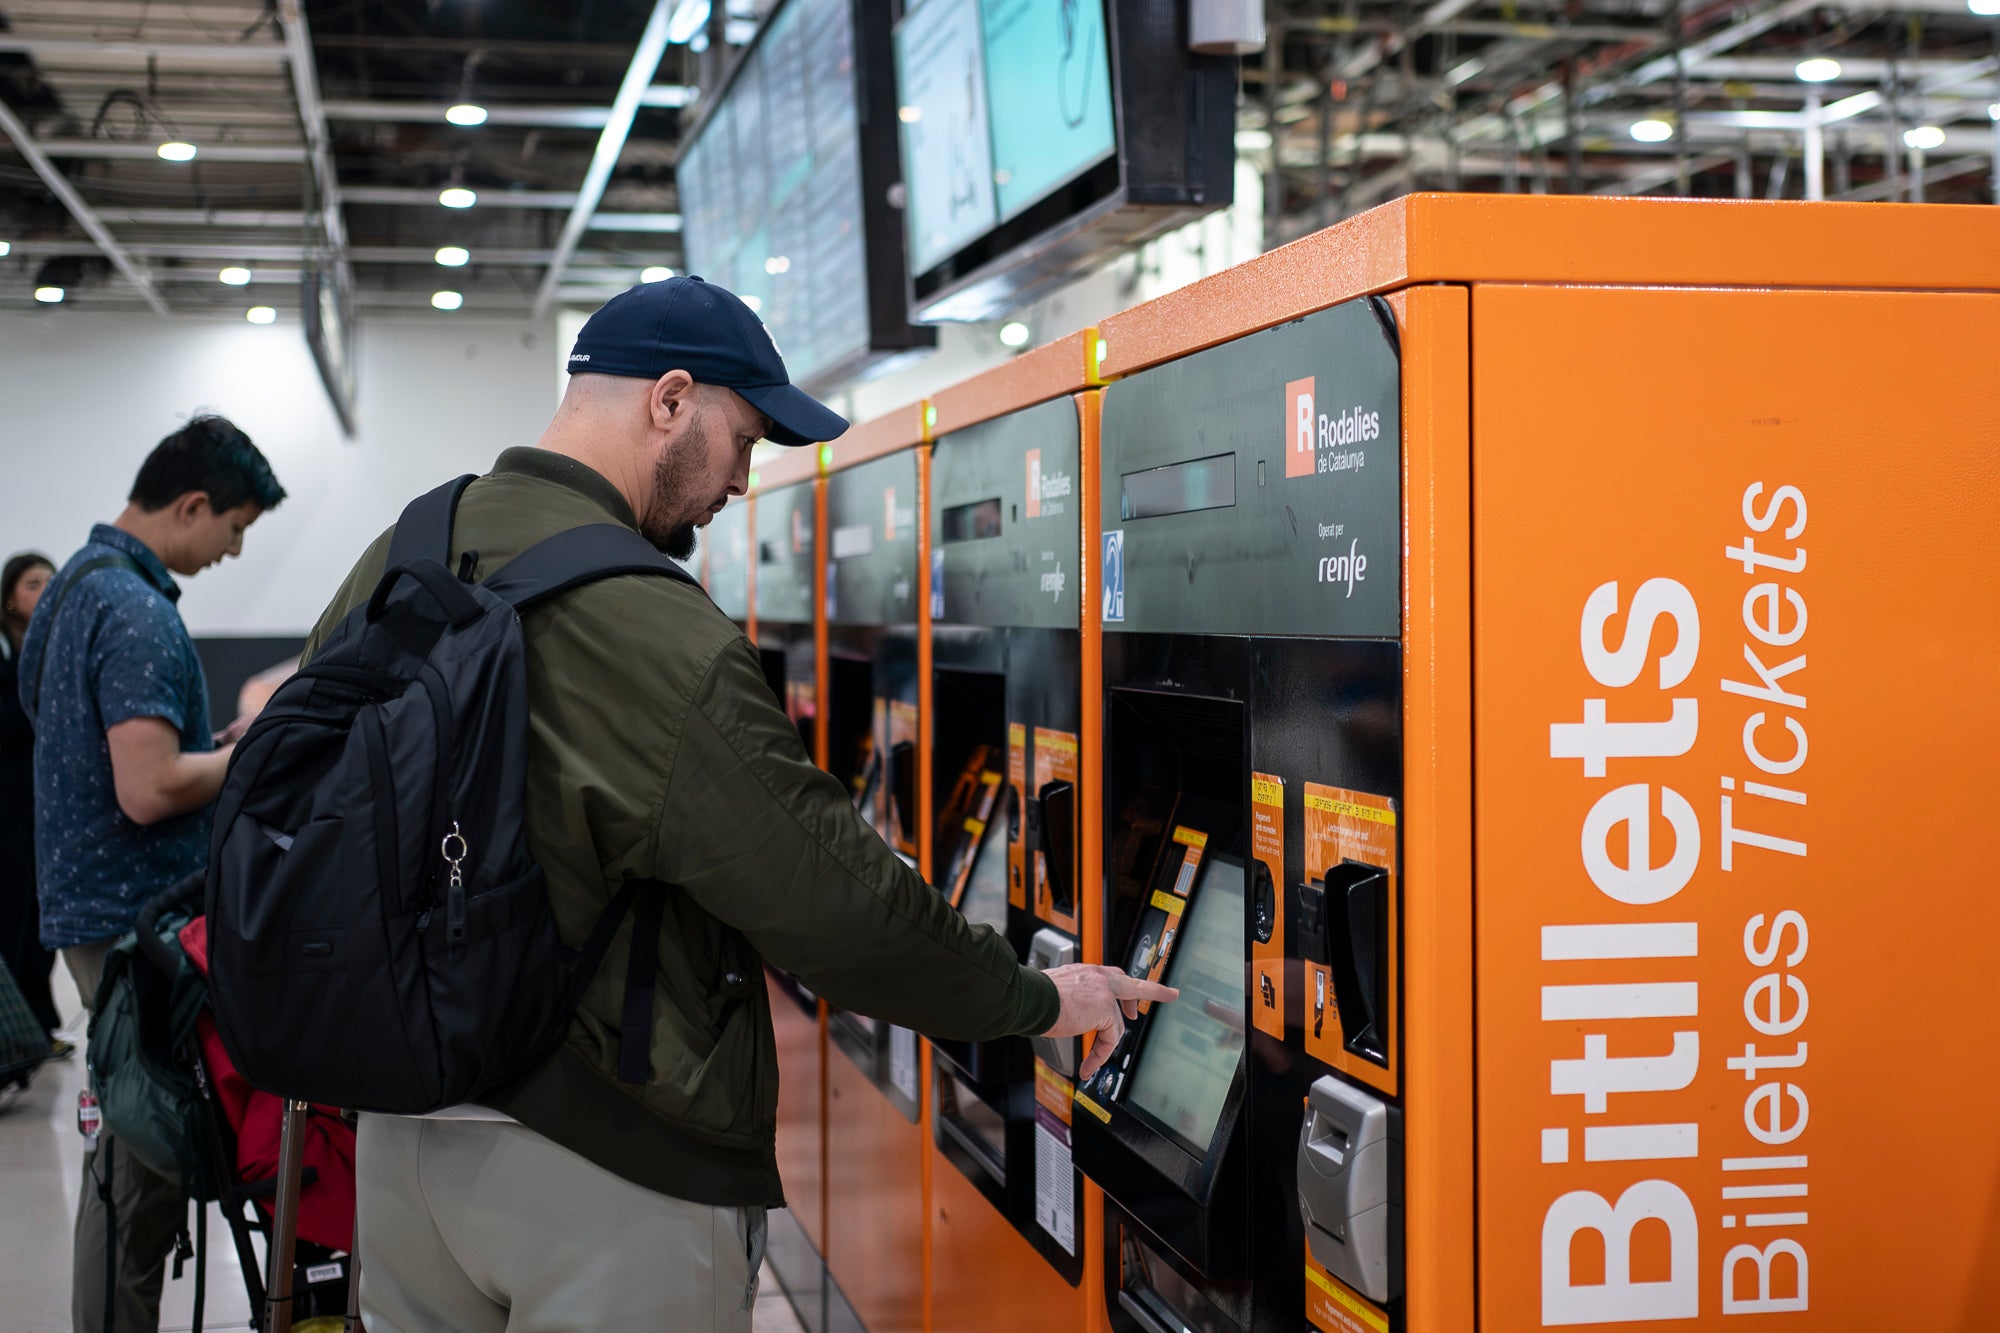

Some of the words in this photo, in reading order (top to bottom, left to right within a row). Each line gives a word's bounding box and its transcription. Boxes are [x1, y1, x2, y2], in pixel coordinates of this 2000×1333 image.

[1297, 393, 1315, 453] R
[1318, 405, 1380, 449] Rodalies
[1317, 453, 1328, 474] de
[1328, 449, 1365, 474] Catalunya
[1318, 522, 1335, 541] Operat
[1335, 523, 1344, 540] per
[1318, 537, 1367, 599] renfe
[1720, 481, 1808, 872] Tickets
[1541, 577, 1700, 1326] Bitllets
[1721, 909, 1809, 1315] Billetes
